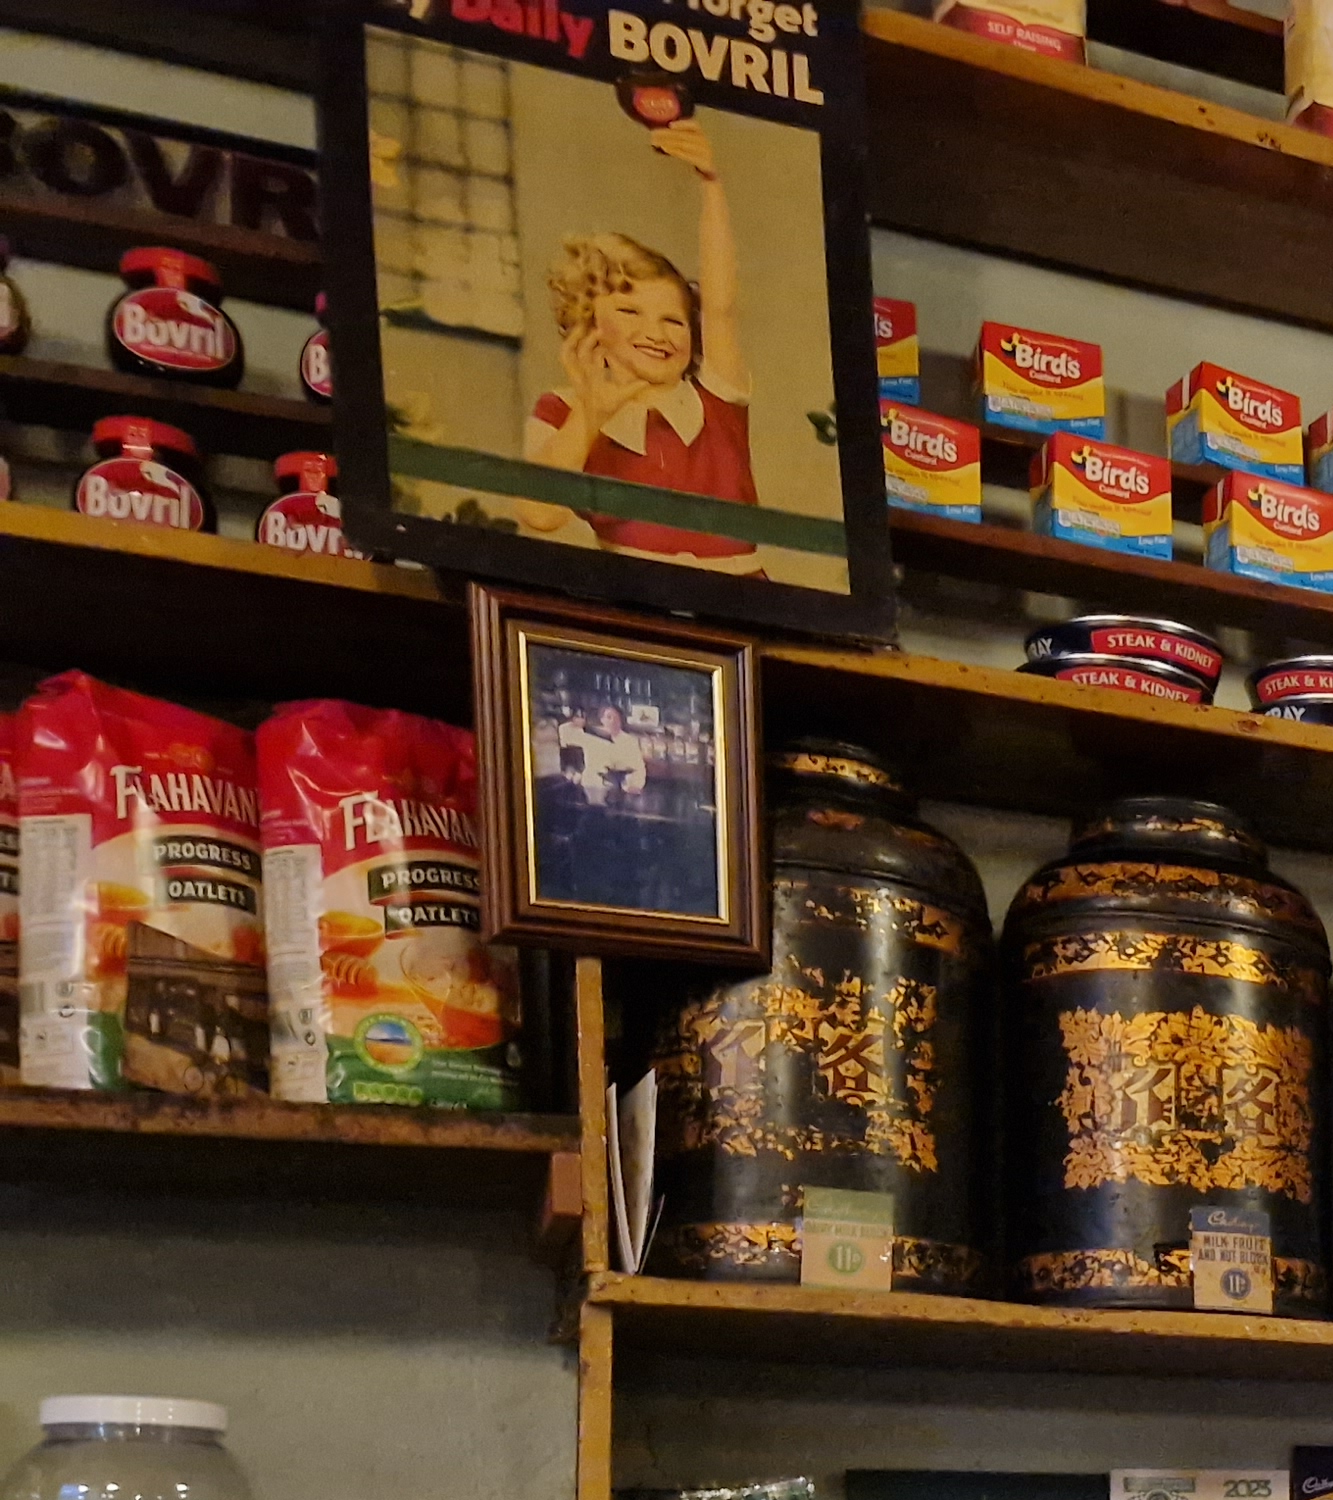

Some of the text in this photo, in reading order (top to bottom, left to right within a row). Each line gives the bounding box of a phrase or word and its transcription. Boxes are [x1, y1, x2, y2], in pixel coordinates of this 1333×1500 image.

[988, 20, 1014, 36] SELF
[608, 9, 825, 106] BOVRIL
[122, 303, 226, 358] Bovril
[84, 475, 193, 529] Bovril
[1107, 629, 1215, 669] STEAK & KIDNEY
[1072, 669, 1190, 703] STEAK & KIDNEY
[1265, 675, 1300, 696] STEAK
[1304, 675, 1316, 687] &
[153, 841, 251, 871] PROGRESS
[168, 879, 246, 904] OATLETS
[1203, 1234, 1266, 1251] MILK FRUIT
[1223, 1479, 1273, 1499] 2023
